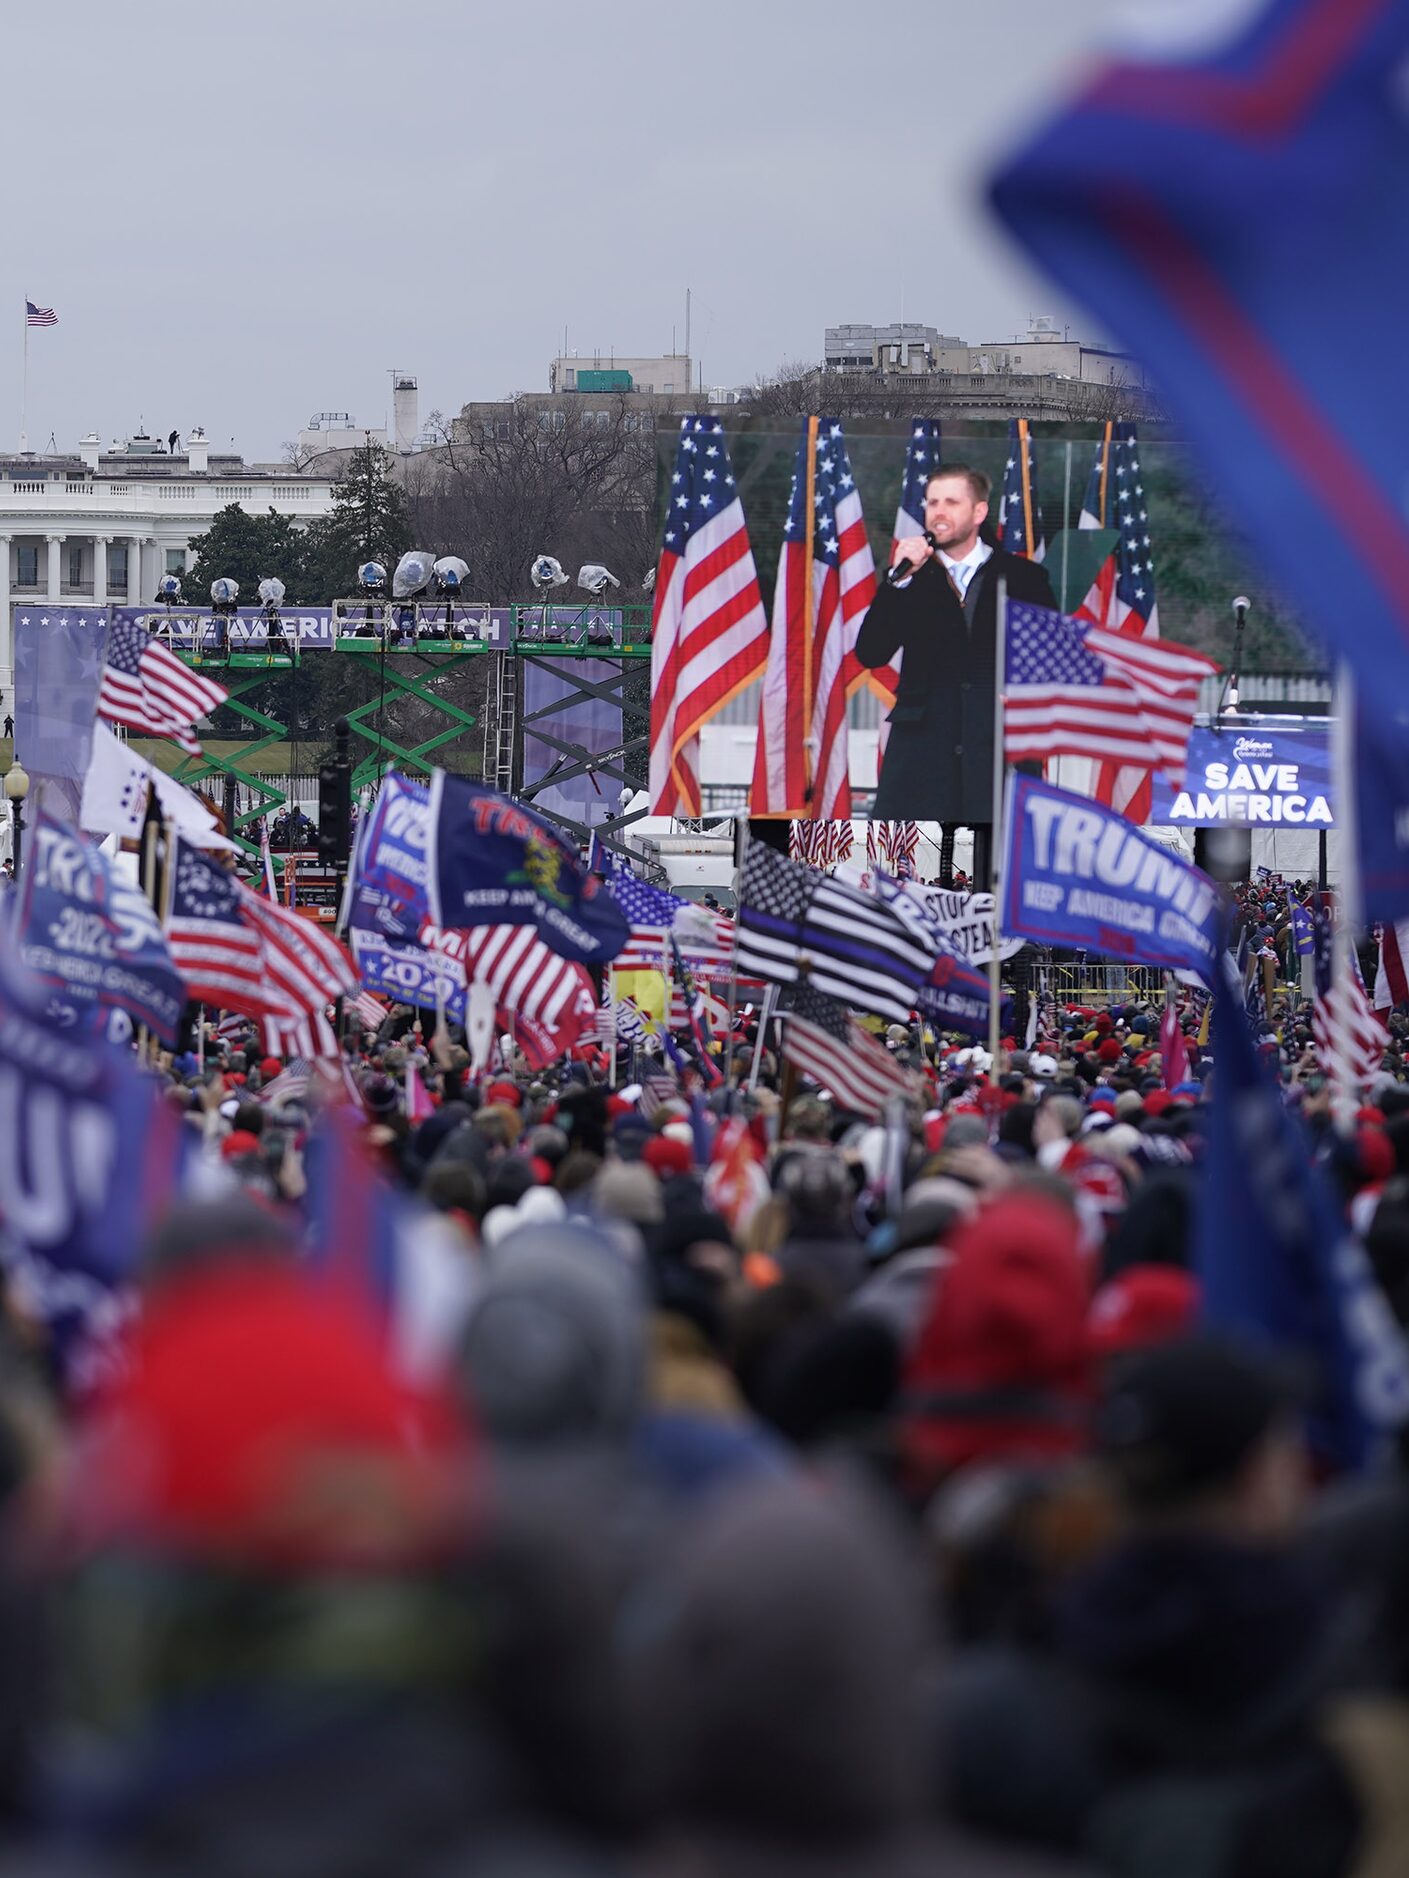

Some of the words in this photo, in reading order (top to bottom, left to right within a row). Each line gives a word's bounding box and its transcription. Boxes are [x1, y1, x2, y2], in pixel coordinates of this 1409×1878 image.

[134, 616, 217, 639] SAVE
[1204, 763, 1300, 792] SAVE
[1168, 792, 1334, 823] AMERICA
[1066, 887, 1156, 933] AMERICA
